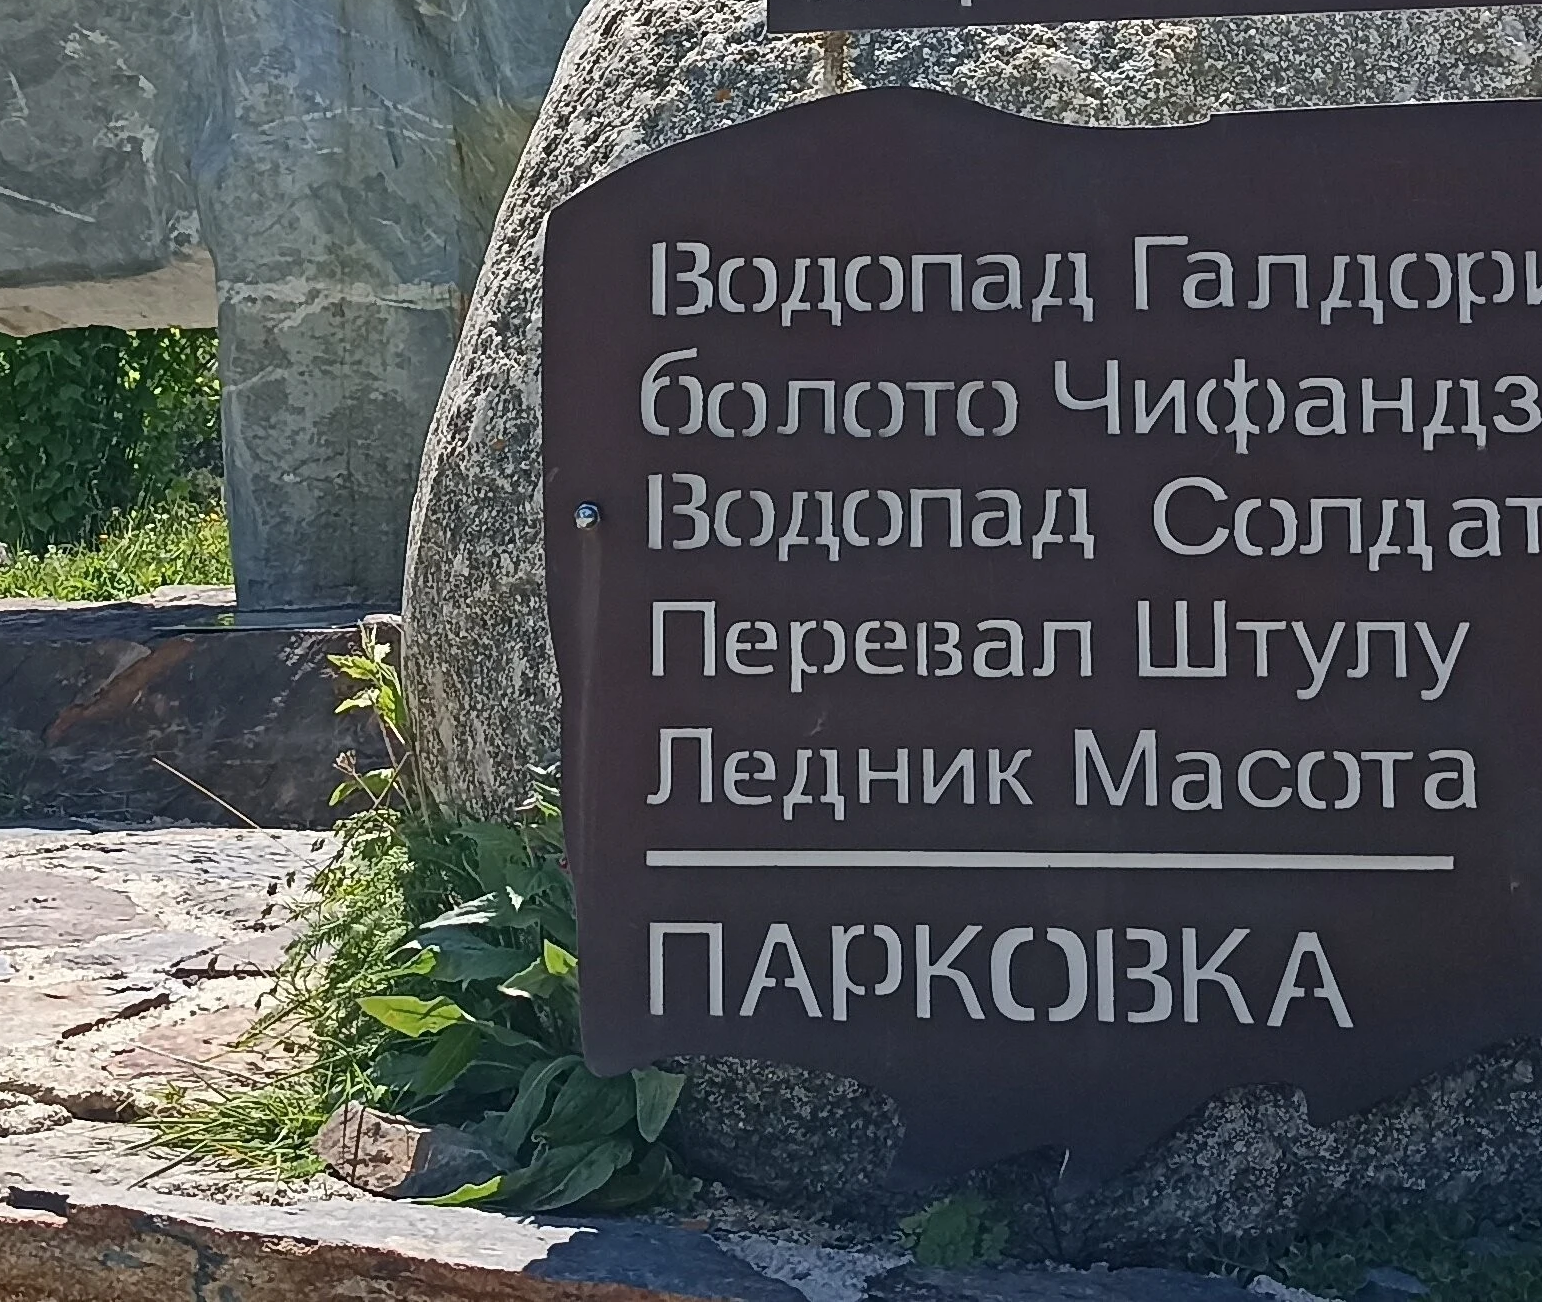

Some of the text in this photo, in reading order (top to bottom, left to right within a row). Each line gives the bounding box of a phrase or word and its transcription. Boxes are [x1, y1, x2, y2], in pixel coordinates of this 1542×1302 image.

[649, 239, 1096, 329] Водопад
[640, 346, 1021, 440] болото
[646, 471, 1097, 564] Водопад
[649, 598, 1472, 702] Перевал Штулу
[645, 726, 1480, 823] Ледник Масота
[648, 921, 1356, 1030] ПАРКОВКА
